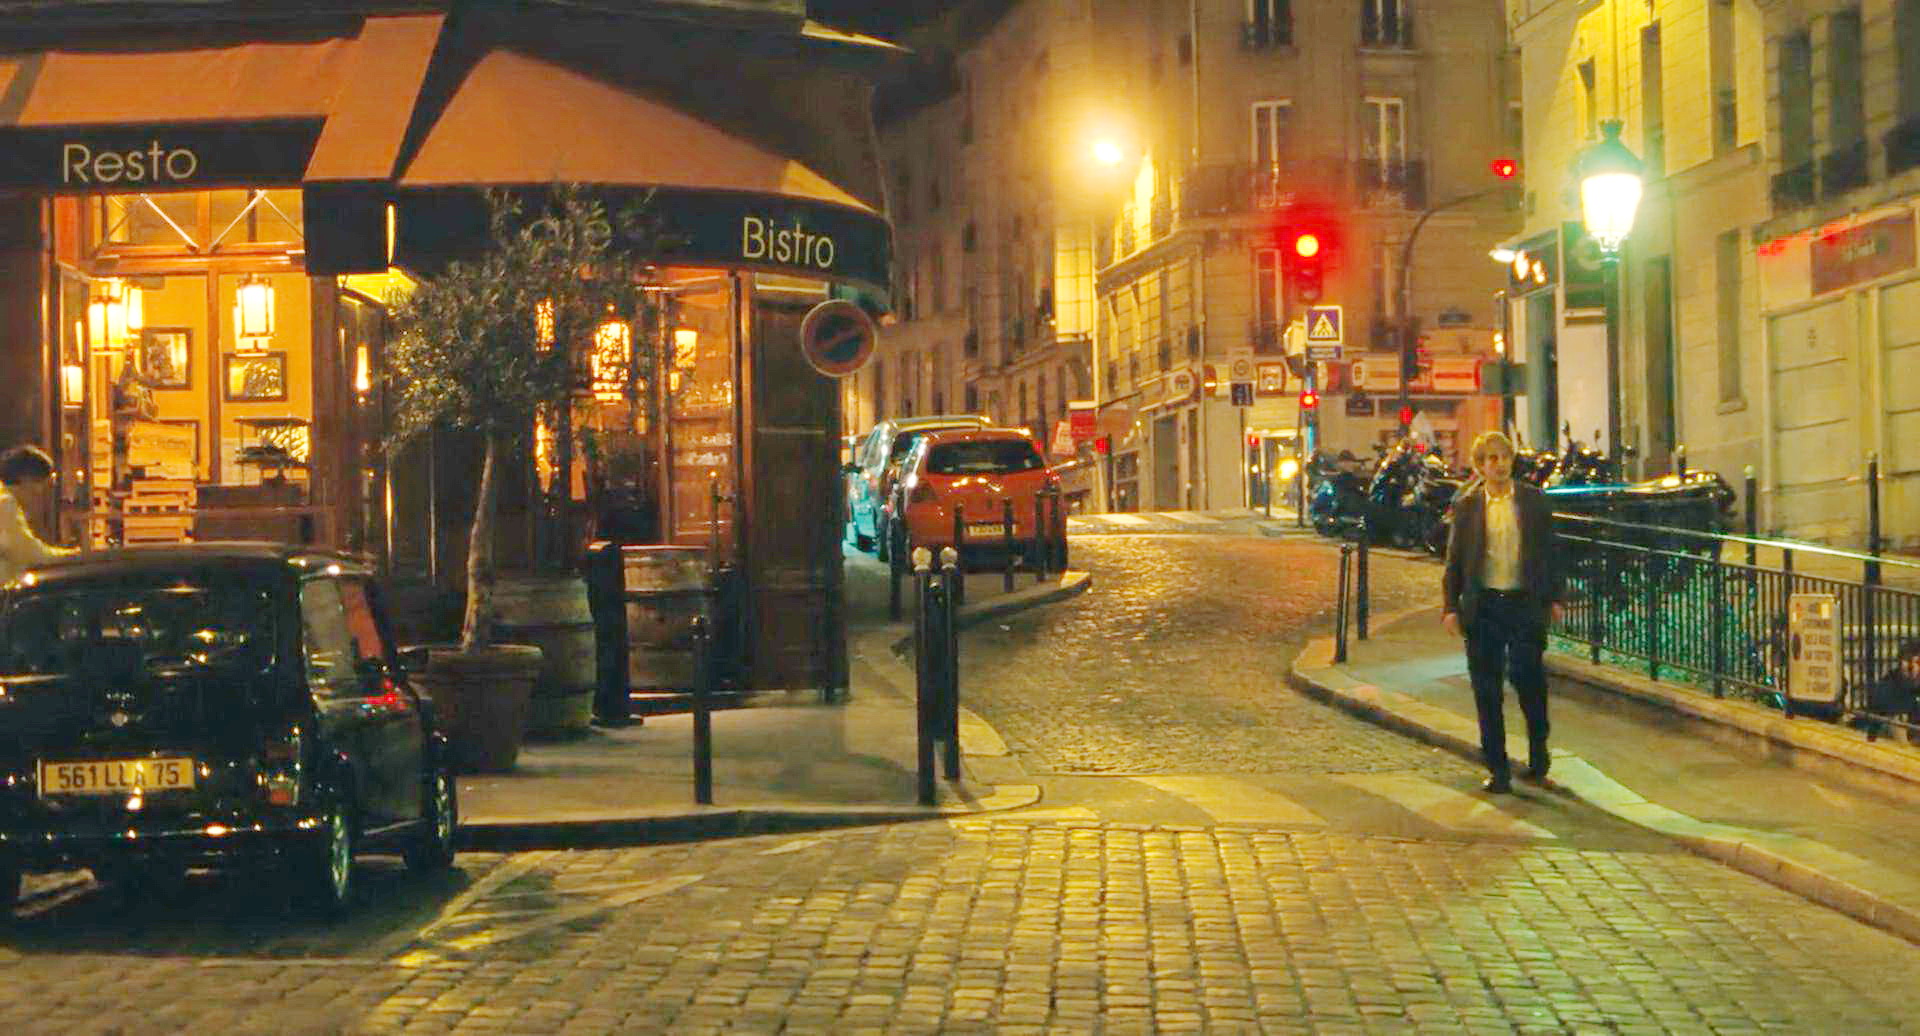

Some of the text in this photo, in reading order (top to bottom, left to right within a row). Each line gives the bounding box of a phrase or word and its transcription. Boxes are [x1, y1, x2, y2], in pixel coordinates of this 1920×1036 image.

[63, 140, 197, 182] Resto
[743, 216, 834, 268] Bistro
[58, 765, 97, 789] 561
[153, 761, 181, 785] 75
